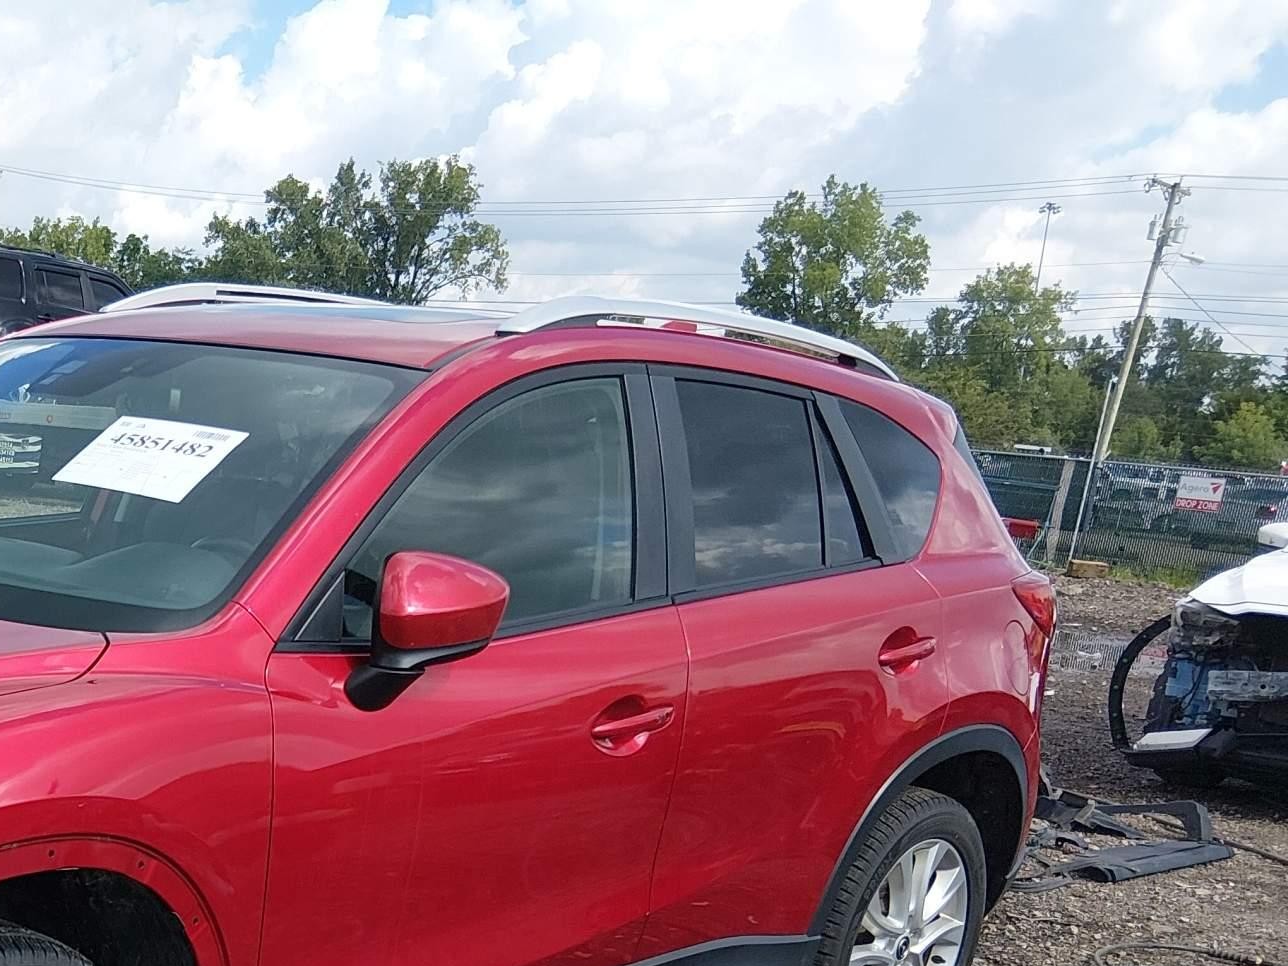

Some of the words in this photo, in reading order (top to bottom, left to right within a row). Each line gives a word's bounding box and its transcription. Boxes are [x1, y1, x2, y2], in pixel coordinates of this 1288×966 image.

[110, 432, 214, 458] 45851482
[1180, 483, 1209, 493] Agero
[1176, 499, 1198, 508] DROP
[1197, 501, 1219, 511] ZONE
